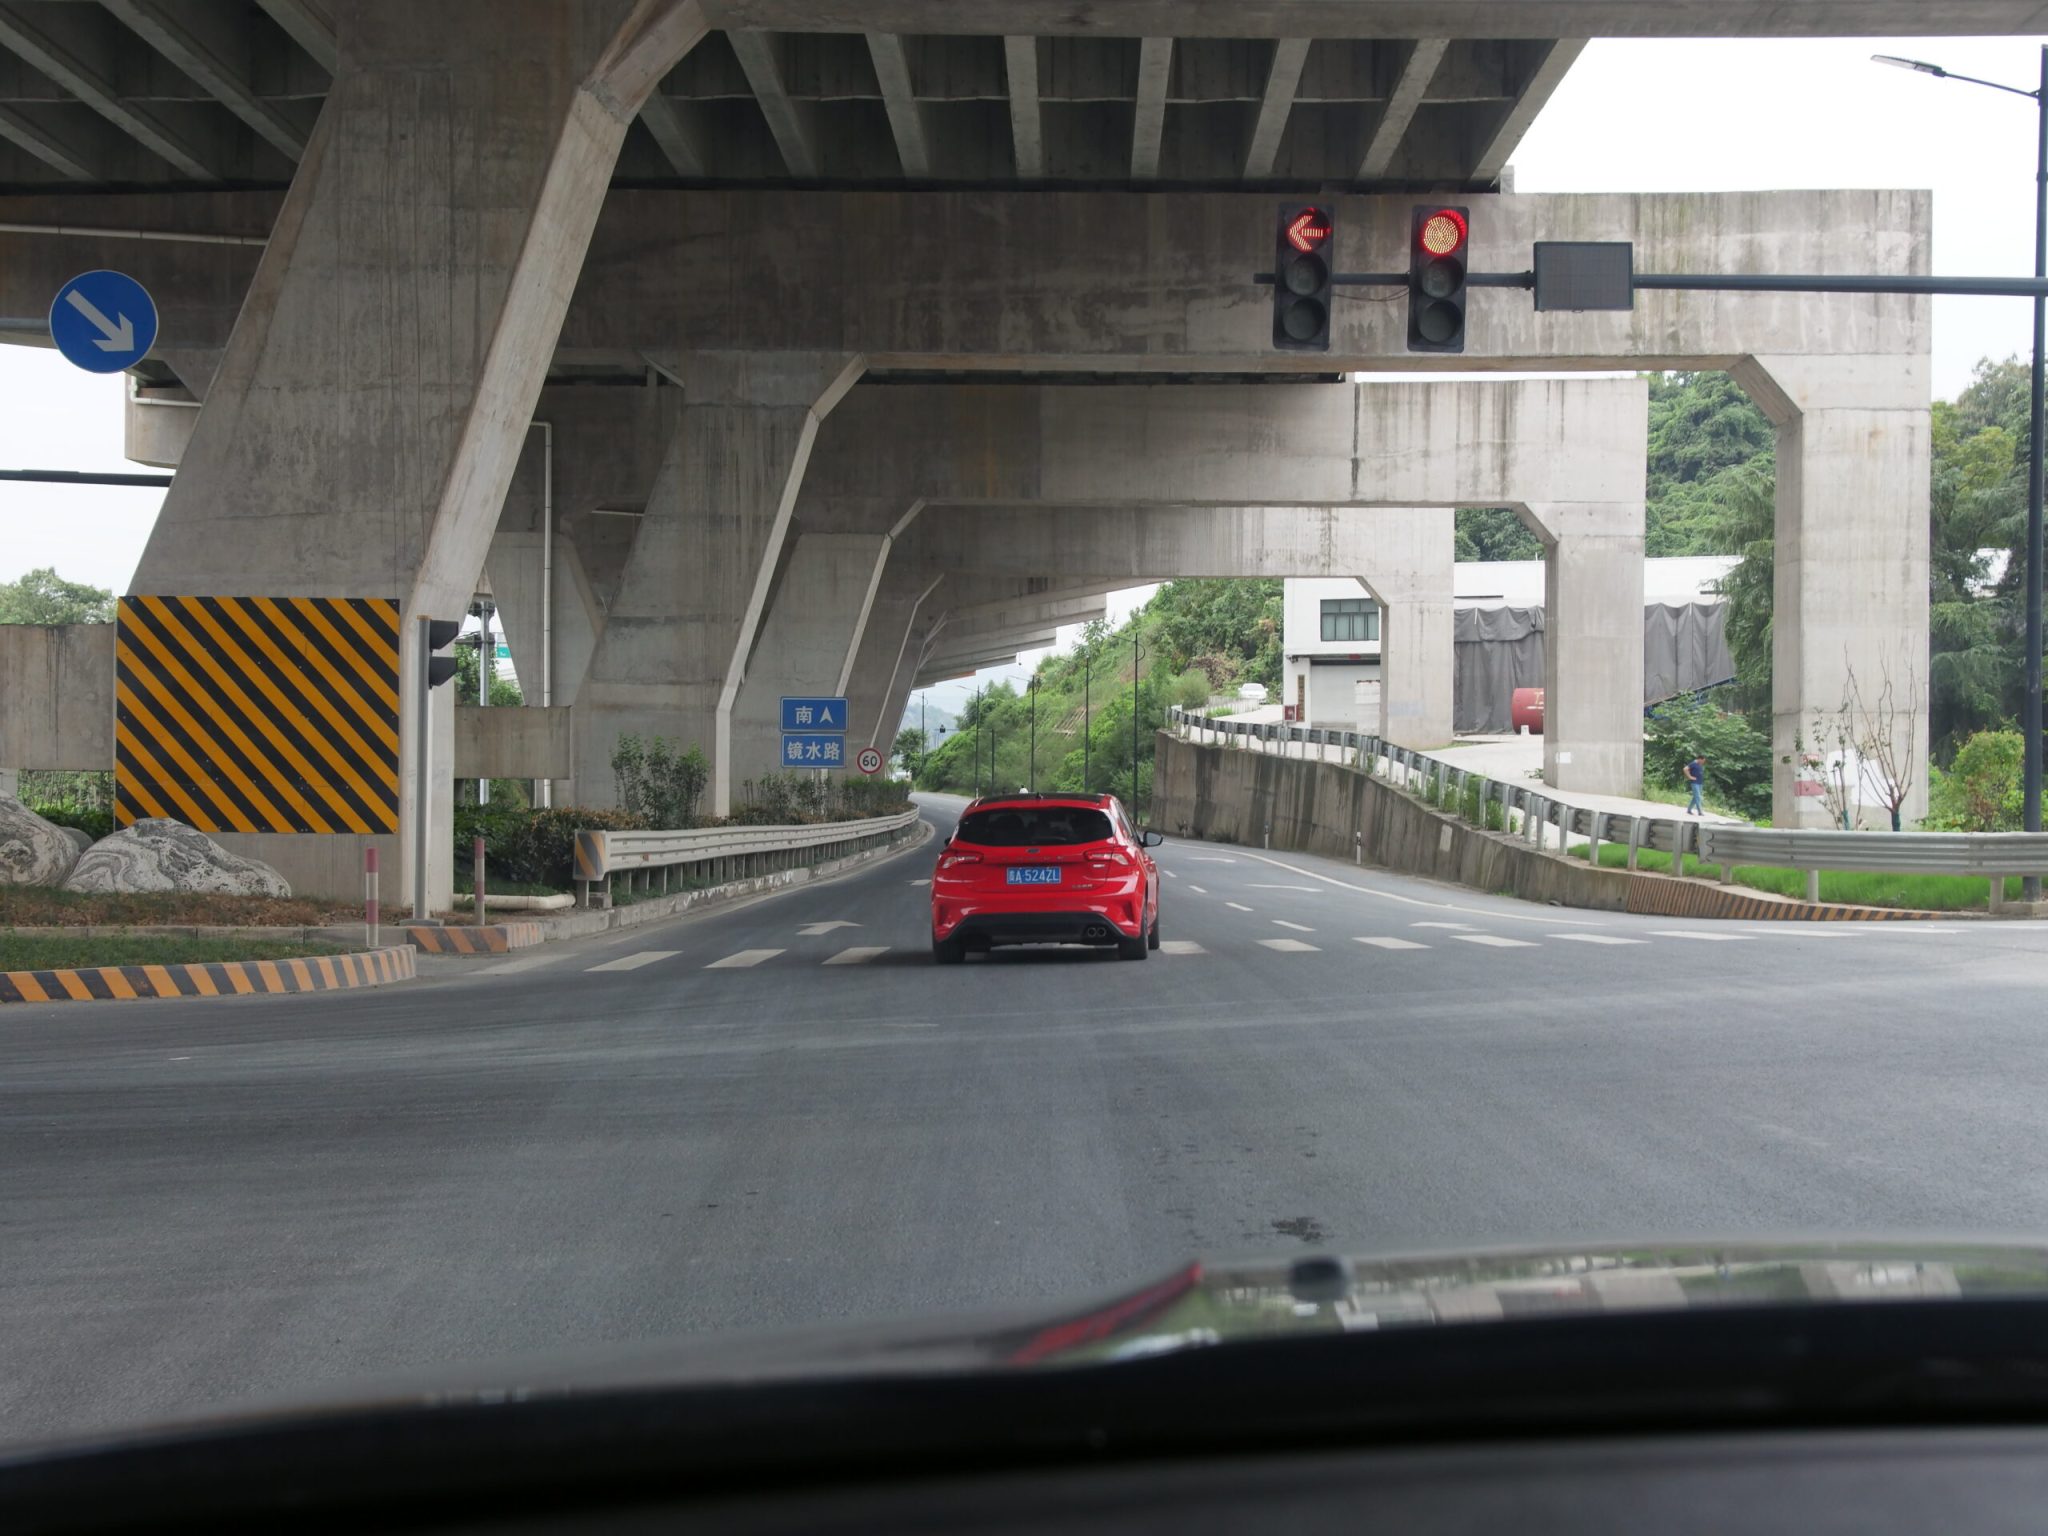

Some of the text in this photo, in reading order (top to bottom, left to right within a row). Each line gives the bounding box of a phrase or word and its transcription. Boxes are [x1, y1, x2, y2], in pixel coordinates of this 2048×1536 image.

[795, 706, 813, 724] 南
[787, 741, 840, 760] 镜水路
[862, 755, 877, 767] 60
